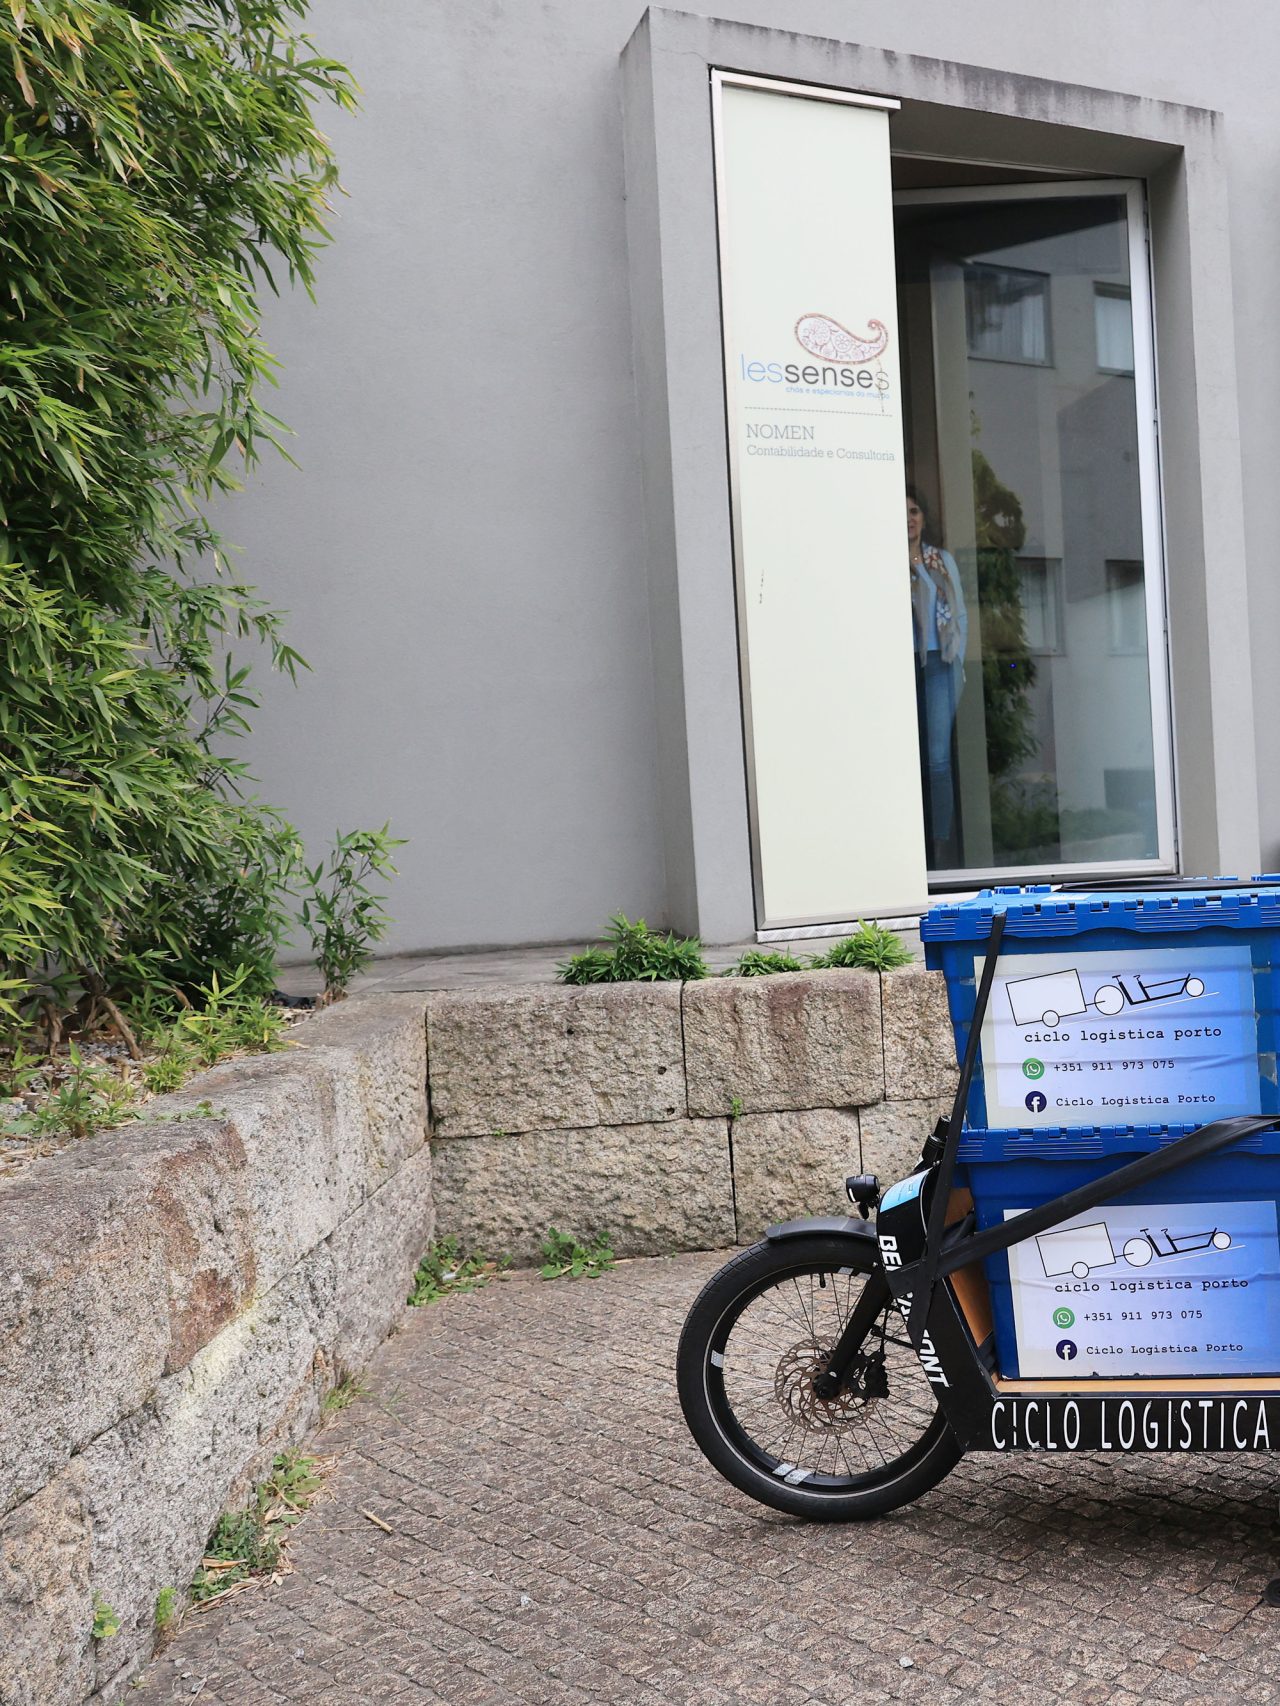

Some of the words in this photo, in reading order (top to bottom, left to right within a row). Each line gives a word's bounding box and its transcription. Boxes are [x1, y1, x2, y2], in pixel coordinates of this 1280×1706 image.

[741, 353, 890, 391] lessenses
[746, 423, 815, 440] NOMEN
[746, 445, 825, 459] Contabilidade
[827, 450, 834, 459] e
[836, 448, 895, 462] Consultoria
[1024, 1030, 1070, 1043] ciclo
[1080, 1027, 1165, 1043] logistica
[1174, 1026, 1222, 1041] porto
[1053, 1062, 1083, 1072] +351
[1091, 1061, 1114, 1071] 911
[1122, 1060, 1144, 1071] 973
[1152, 1060, 1175, 1070] 075
[1055, 1096, 1094, 1107] Ciclo
[1101, 1094, 1169, 1107] Logistica
[1178, 1093, 1216, 1104] Porto
[1054, 1281, 1100, 1293] ciclo
[1110, 1280, 1192, 1293] logistica
[1202, 1278, 1249, 1291] porto
[1083, 1311, 1113, 1321] +351
[1121, 1311, 1142, 1321] 911
[1151, 1310, 1173, 1320] 973
[1181, 1310, 1203, 1319] 075
[1086, 1345, 1124, 1355] Ciclo
[1131, 1343, 1200, 1356] Logistica
[1206, 1342, 1243, 1352] Porto
[991, 1400, 1081, 1450] CICLO
[1101, 1399, 1270, 1450] LOGISTICA
